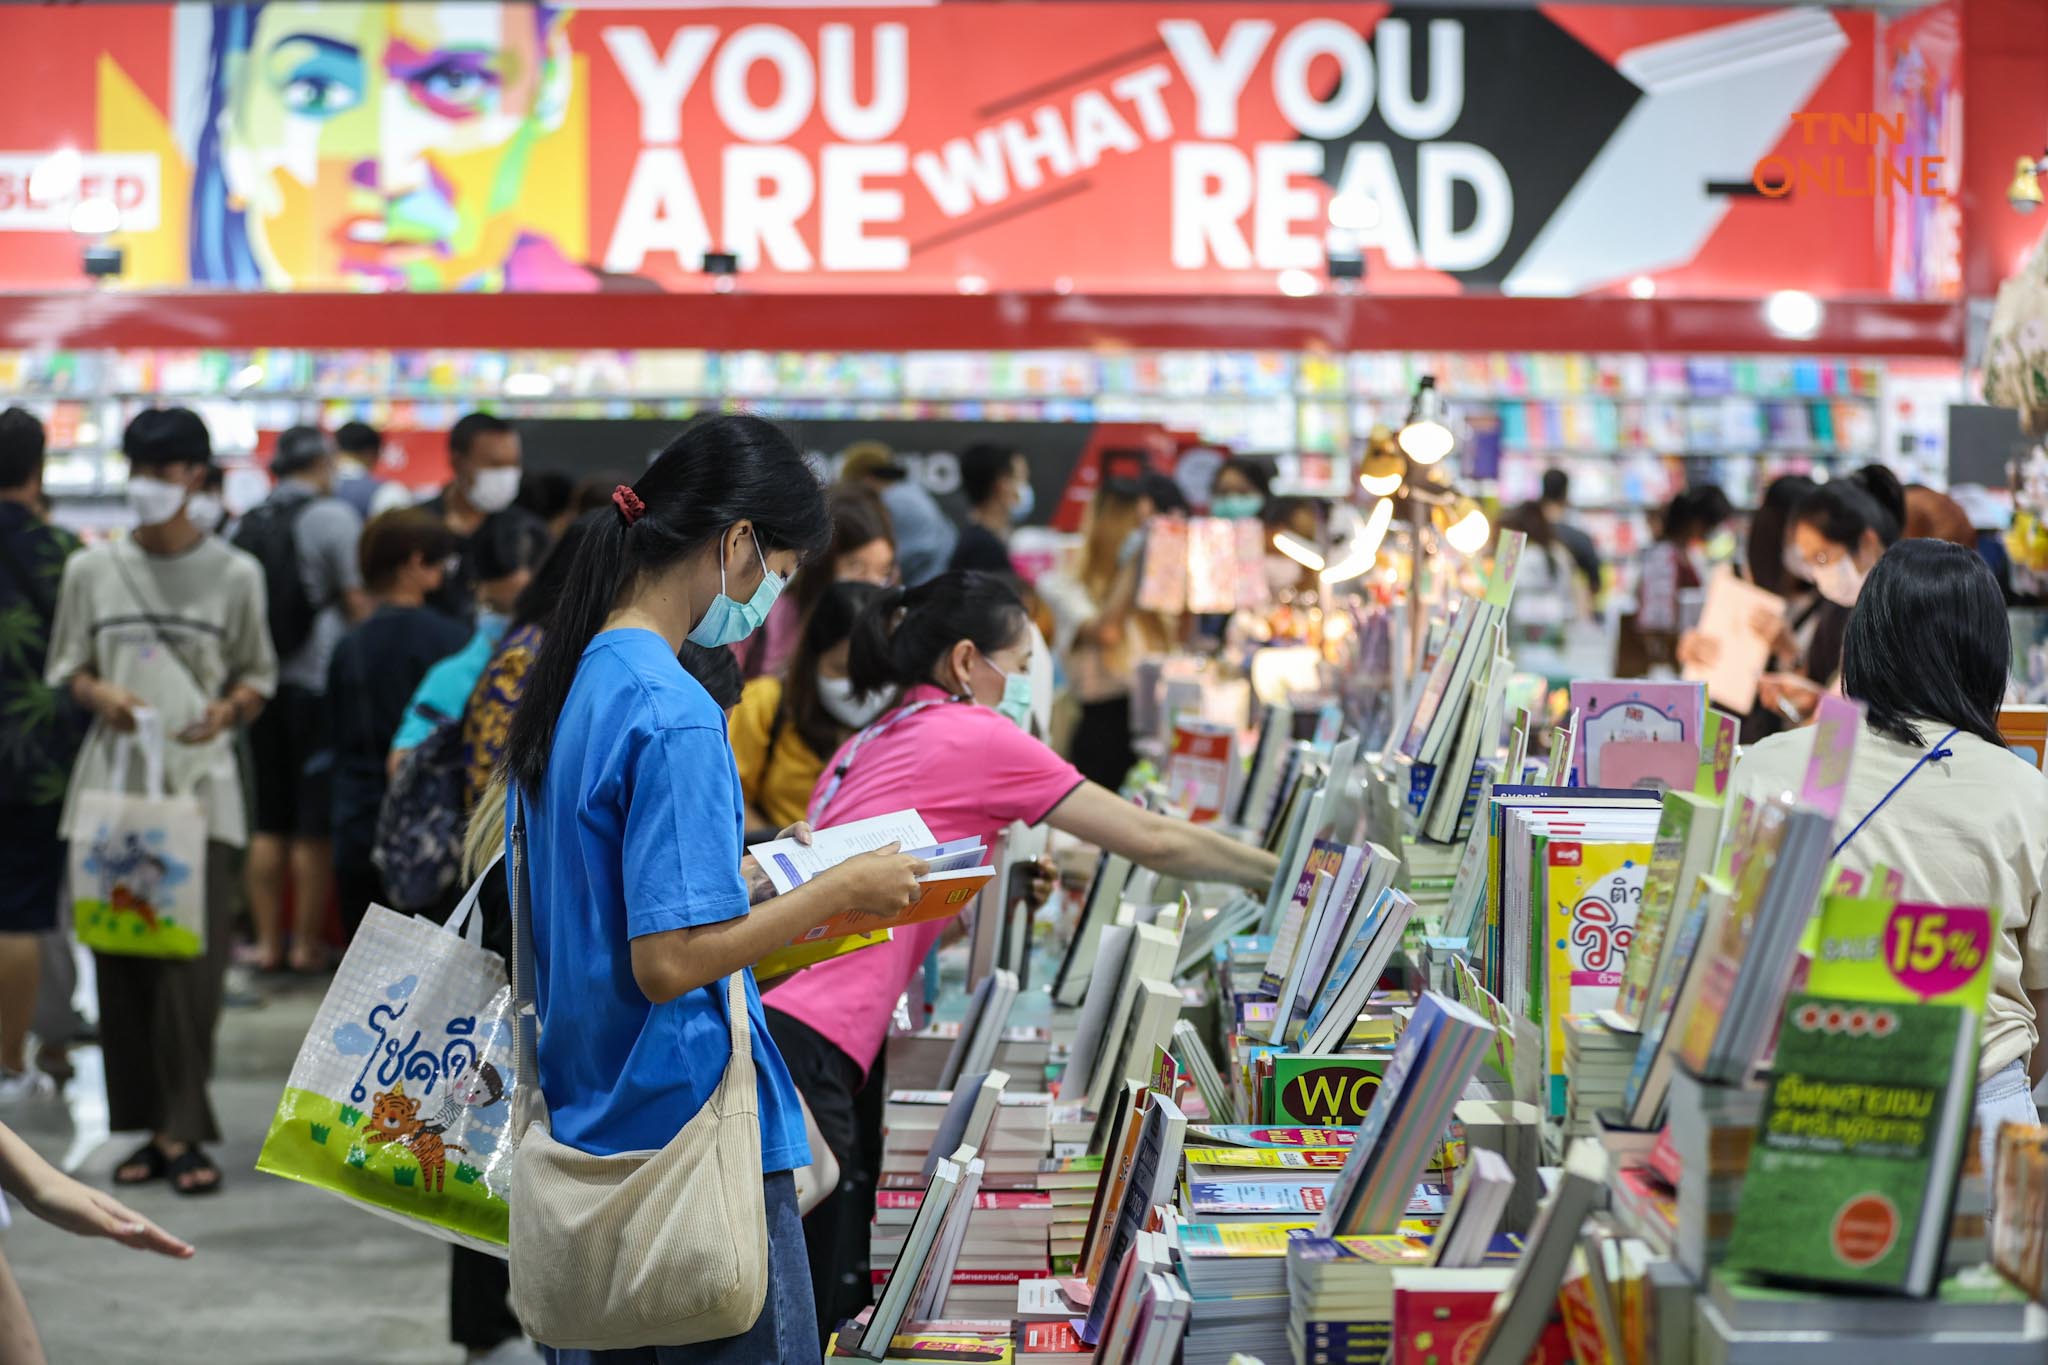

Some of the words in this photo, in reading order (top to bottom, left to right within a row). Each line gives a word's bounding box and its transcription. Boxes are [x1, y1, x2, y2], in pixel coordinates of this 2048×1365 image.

[602, 23, 909, 144] YOU
[913, 63, 1174, 218] WHAT
[1158, 18, 1466, 142] YOU
[602, 142, 910, 274] ARE
[1171, 140, 1514, 273] READ
[1821, 936, 1879, 961] SALE
[1893, 913, 1982, 974] 15%
[350, 1002, 477, 1103] โชคดี
